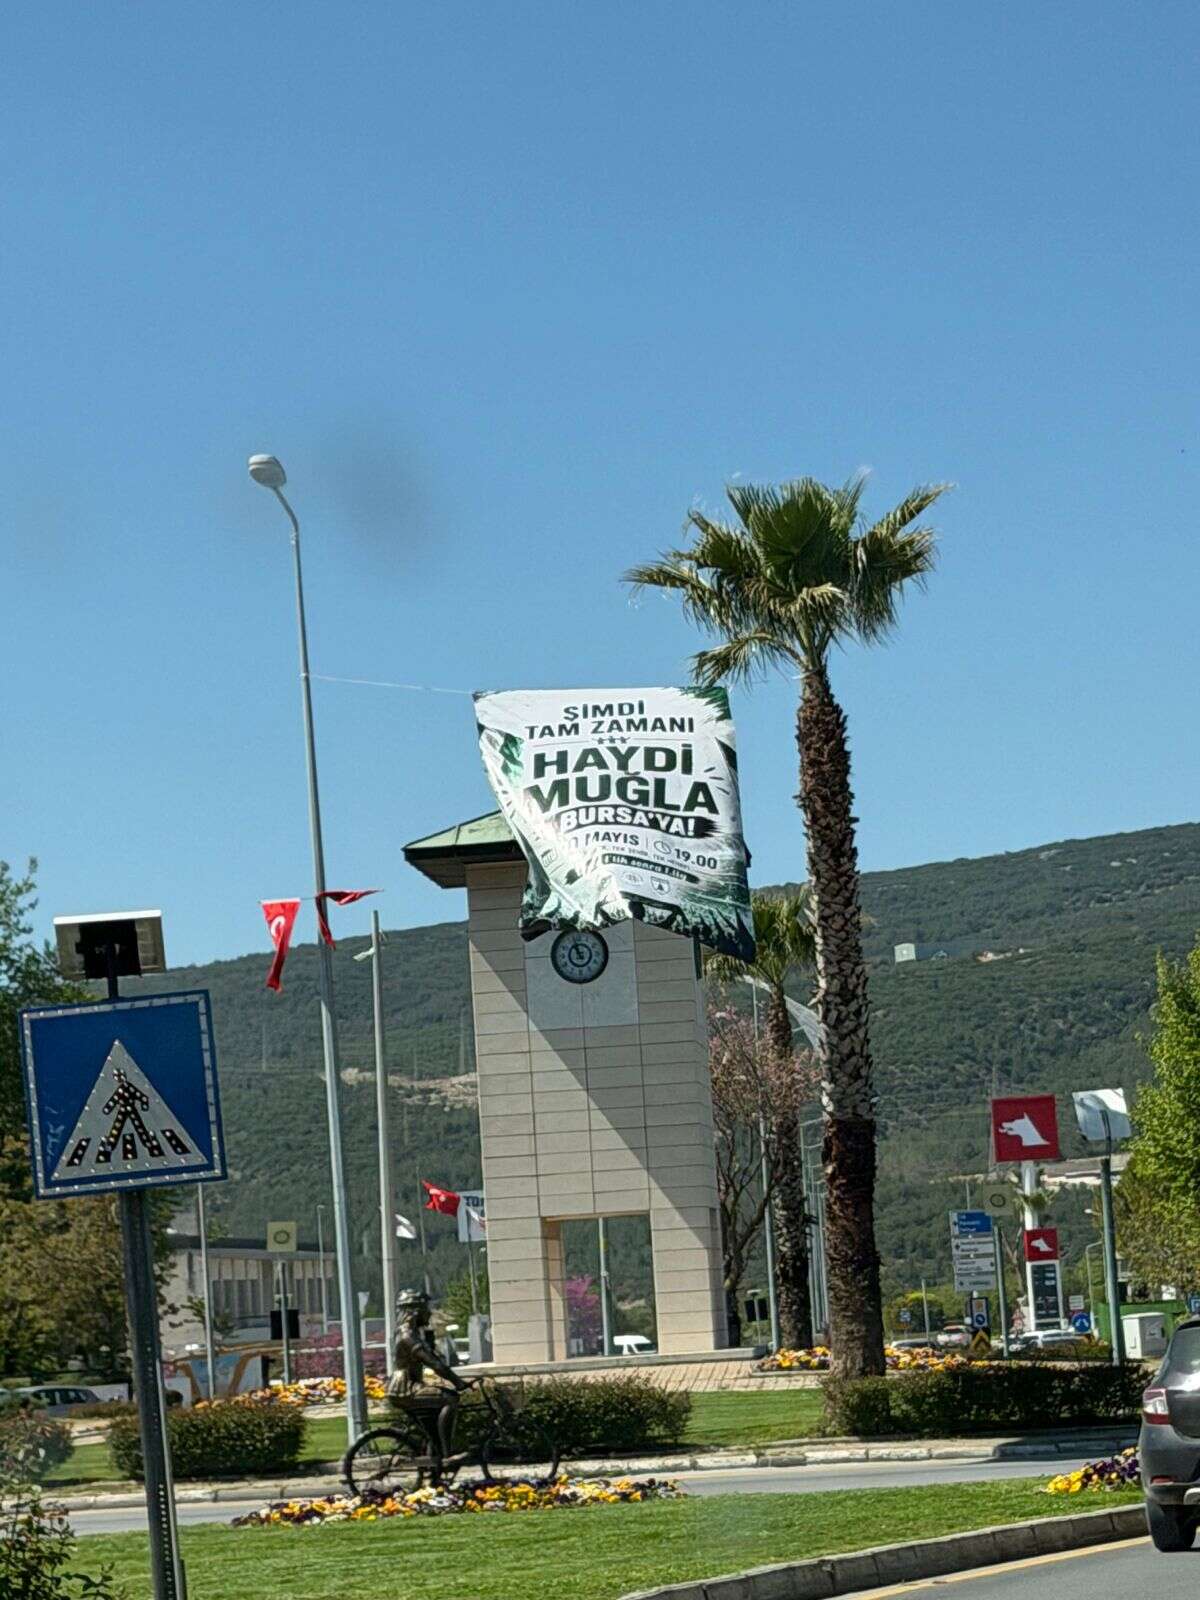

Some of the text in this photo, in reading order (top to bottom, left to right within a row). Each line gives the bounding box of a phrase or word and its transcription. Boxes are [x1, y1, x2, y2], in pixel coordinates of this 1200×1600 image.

[524, 717, 694, 740] TAM ZAMANI
[533, 743, 693, 779] HAYDİ
[523, 771, 720, 815] MUĞLA
[559, 805, 696, 837] BURSA'YA!
[674, 848, 718, 870] 19.00
